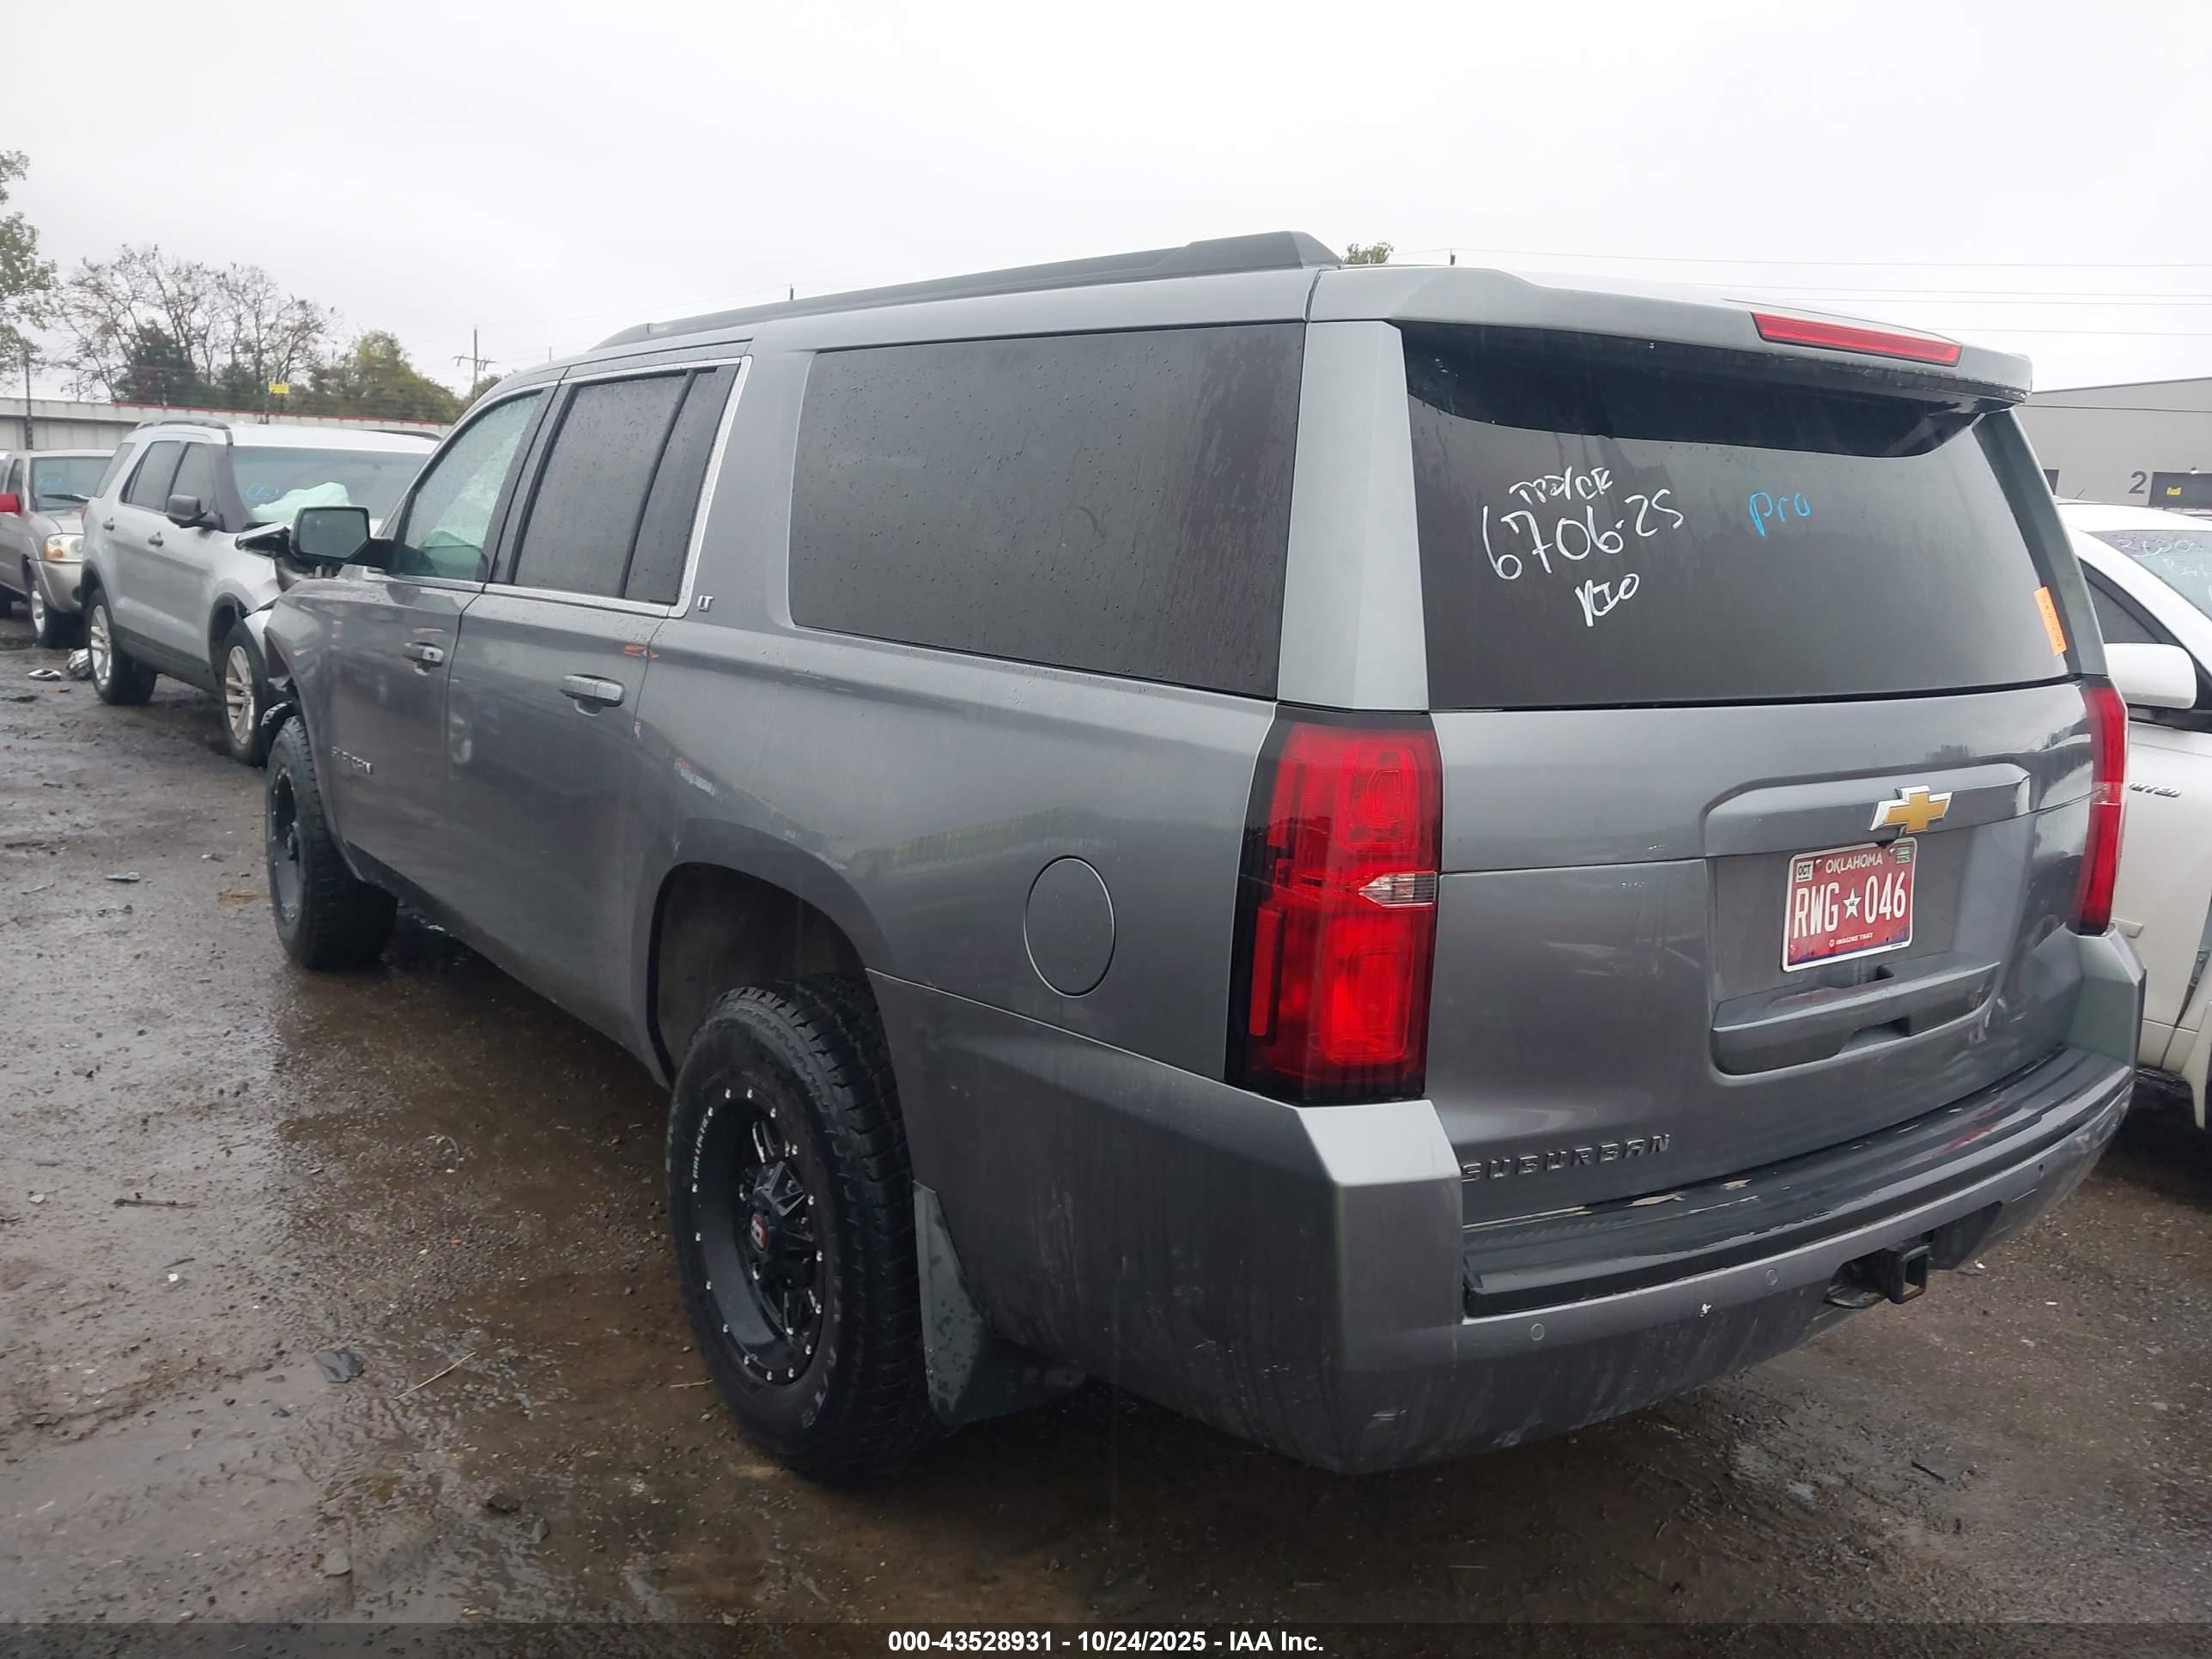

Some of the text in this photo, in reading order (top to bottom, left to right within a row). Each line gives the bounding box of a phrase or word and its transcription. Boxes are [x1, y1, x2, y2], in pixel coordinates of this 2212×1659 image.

[2129, 471, 2148, 494] 2
[696, 594, 714, 611] LT
[1797, 864, 1812, 877] OCT
[1826, 853, 1883, 874] OKLAHOMA
[1793, 871, 1906, 939] RWG 046
[1460, 1133, 1671, 1182] SUBURBAN
